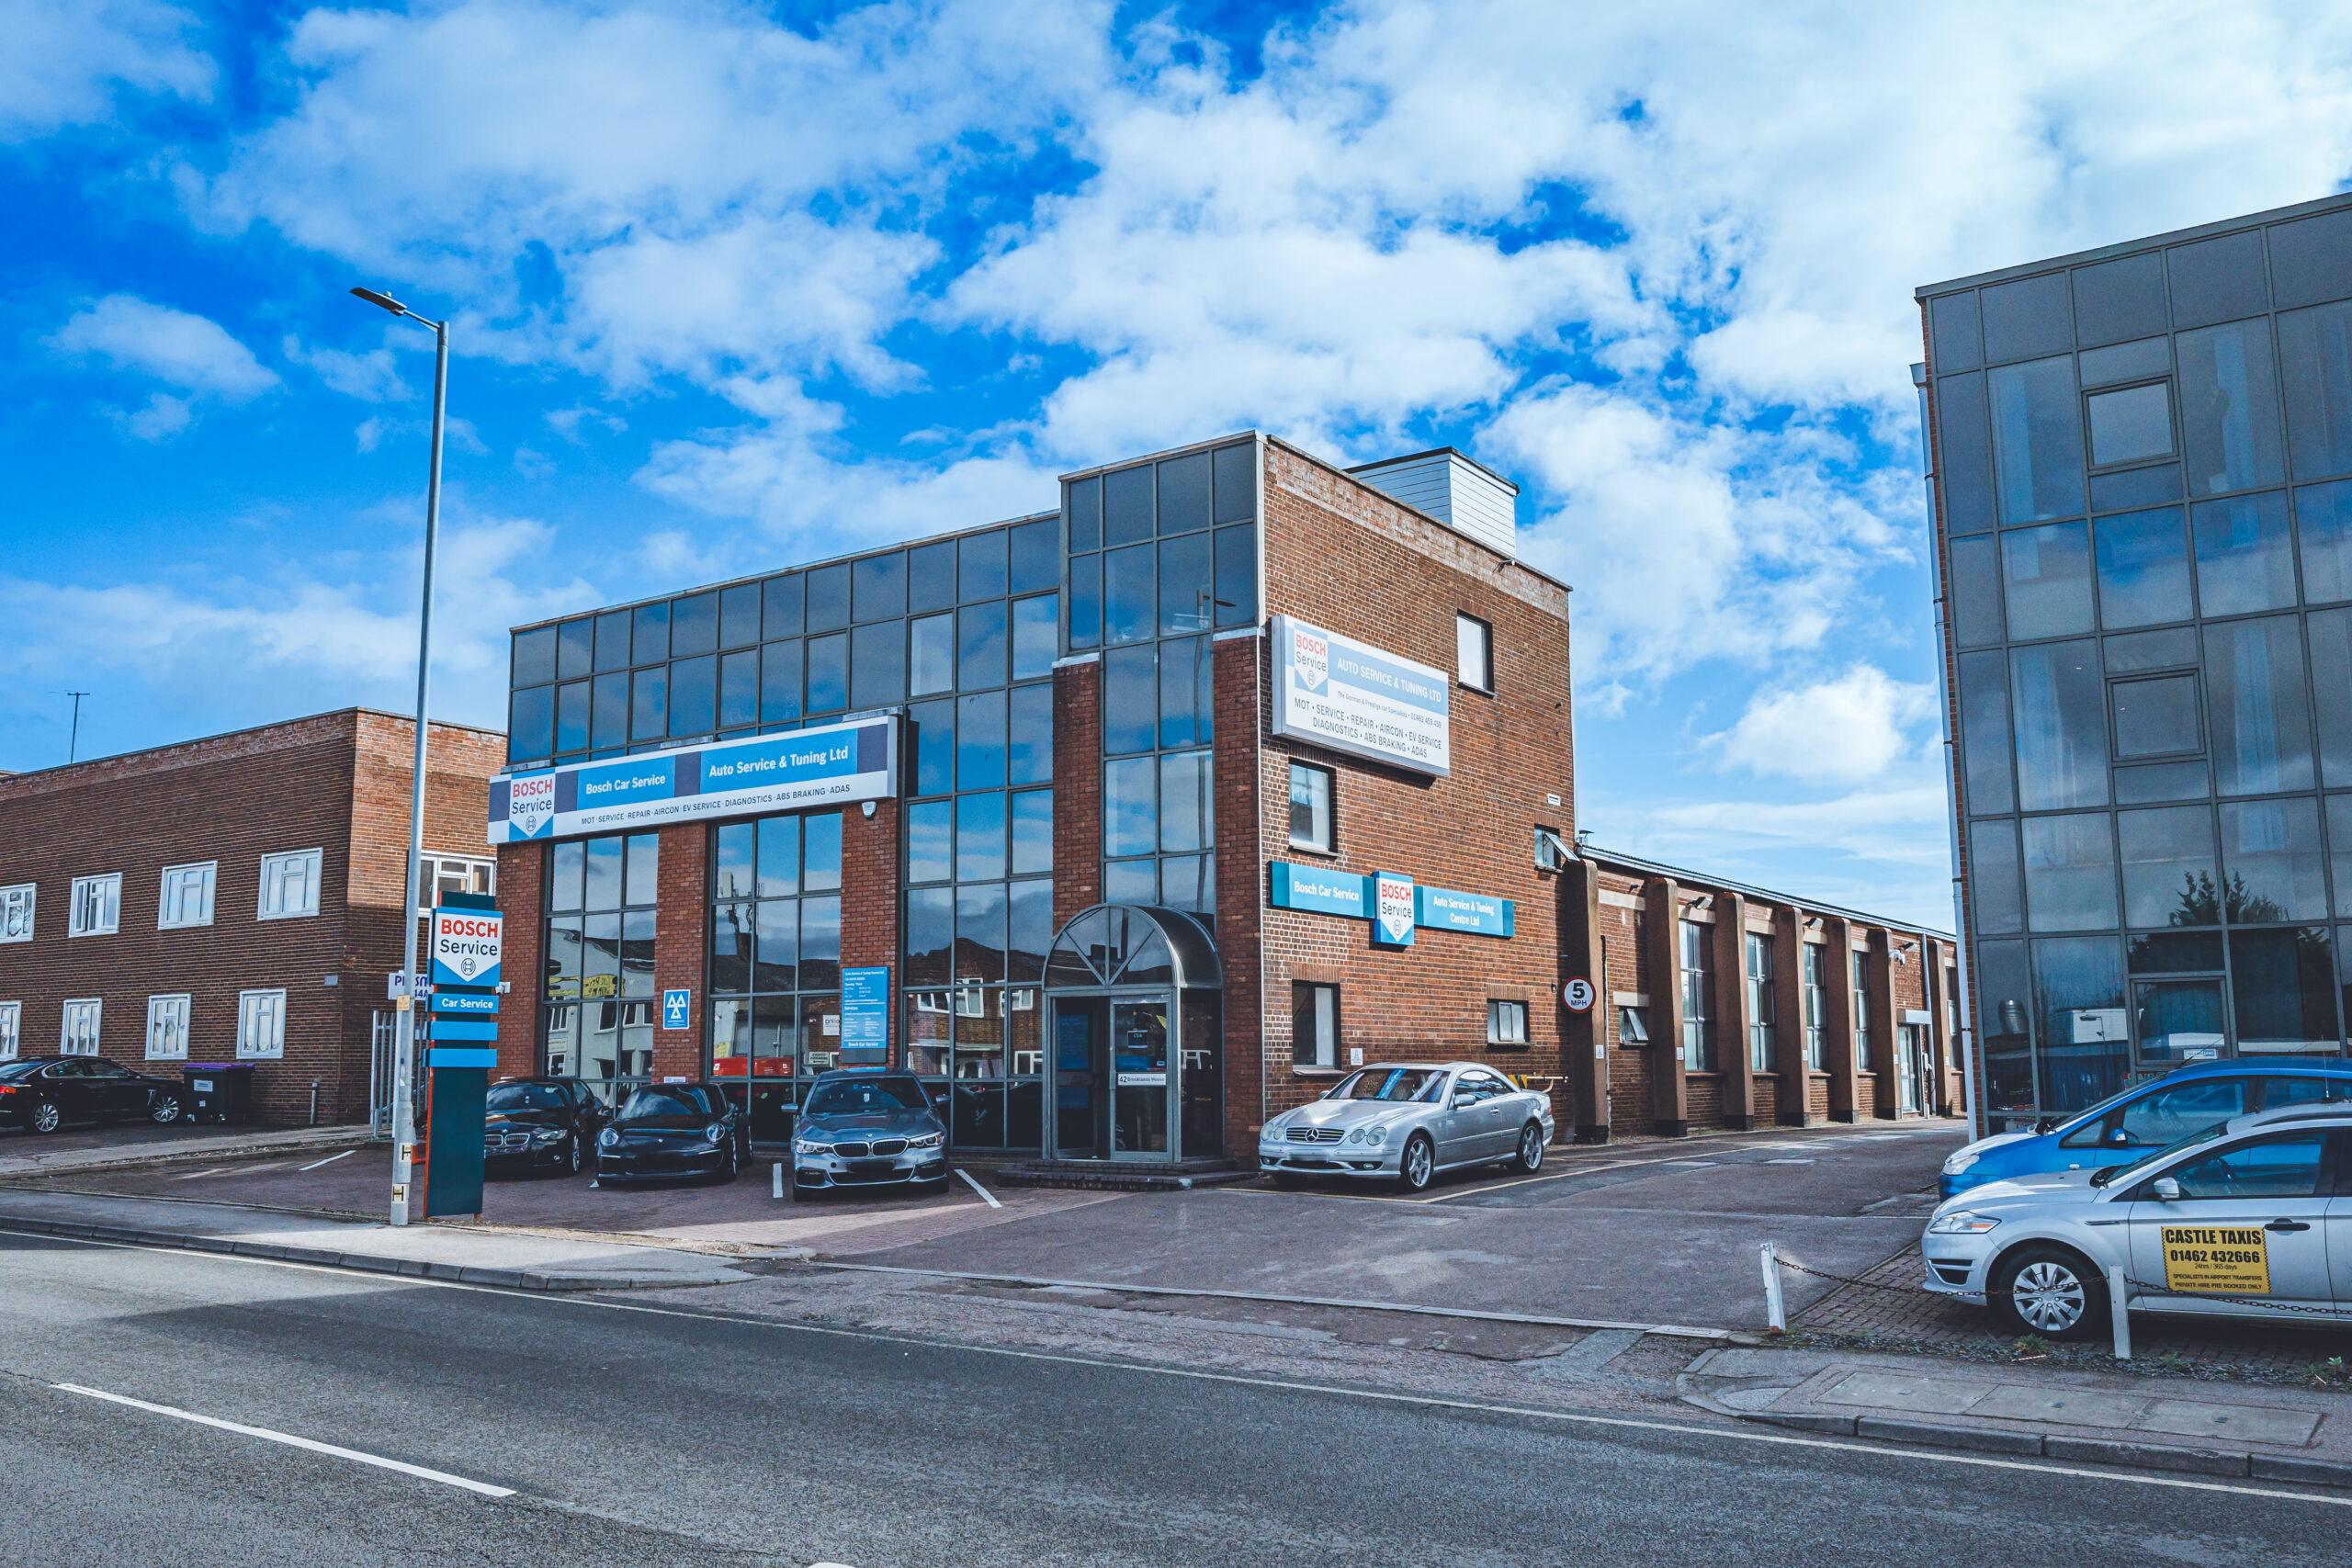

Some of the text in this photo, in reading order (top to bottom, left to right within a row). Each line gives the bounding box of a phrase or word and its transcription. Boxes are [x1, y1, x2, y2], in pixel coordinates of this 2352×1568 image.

[1295, 634, 1326, 656] BOSCH
[1296, 651, 1326, 671] Service
[1338, 658, 1442, 702] AUTO SERVICE & TUNING LTD
[1295, 697, 1442, 750] MOT SERVICE REPAIR AIRCON EV SERVICE
[1313, 717, 1427, 758] DIAGNOSTICS ABS BRAKING ADAS
[709, 746, 848, 777] Auto Service & Tuning Ltd
[513, 779, 551, 797] BOSCH
[586, 774, 666, 795] Bosch Car Service
[512, 798, 551, 814] Service
[598, 813, 624, 822] SERVICE
[628, 809, 650, 818] REPAIR
[654, 806, 679, 816] AIRCON
[694, 800, 721, 810] SERVICE
[726, 795, 772, 807] DIAGNOSTICS
[776, 793, 790, 801] ABS
[793, 787, 826, 798] BRAKING
[830, 784, 851, 794] ADAS
[1294, 881, 1359, 901] Bosch Car Service
[1382, 884, 1411, 901] BOSCH
[1382, 902, 1411, 918] Service
[1433, 896, 1494, 917] Auto Service & Tuning
[441, 919, 498, 938] BOSCH
[1450, 913, 1480, 926] Centre Ltd
[440, 939, 497, 955] Service
[1573, 983, 1585, 998] 5
[442, 998, 493, 1009] Car Service
[2165, 1229, 2261, 1245] CASTLE TAXIS
[2171, 1250, 2260, 1263] 01462 432666
